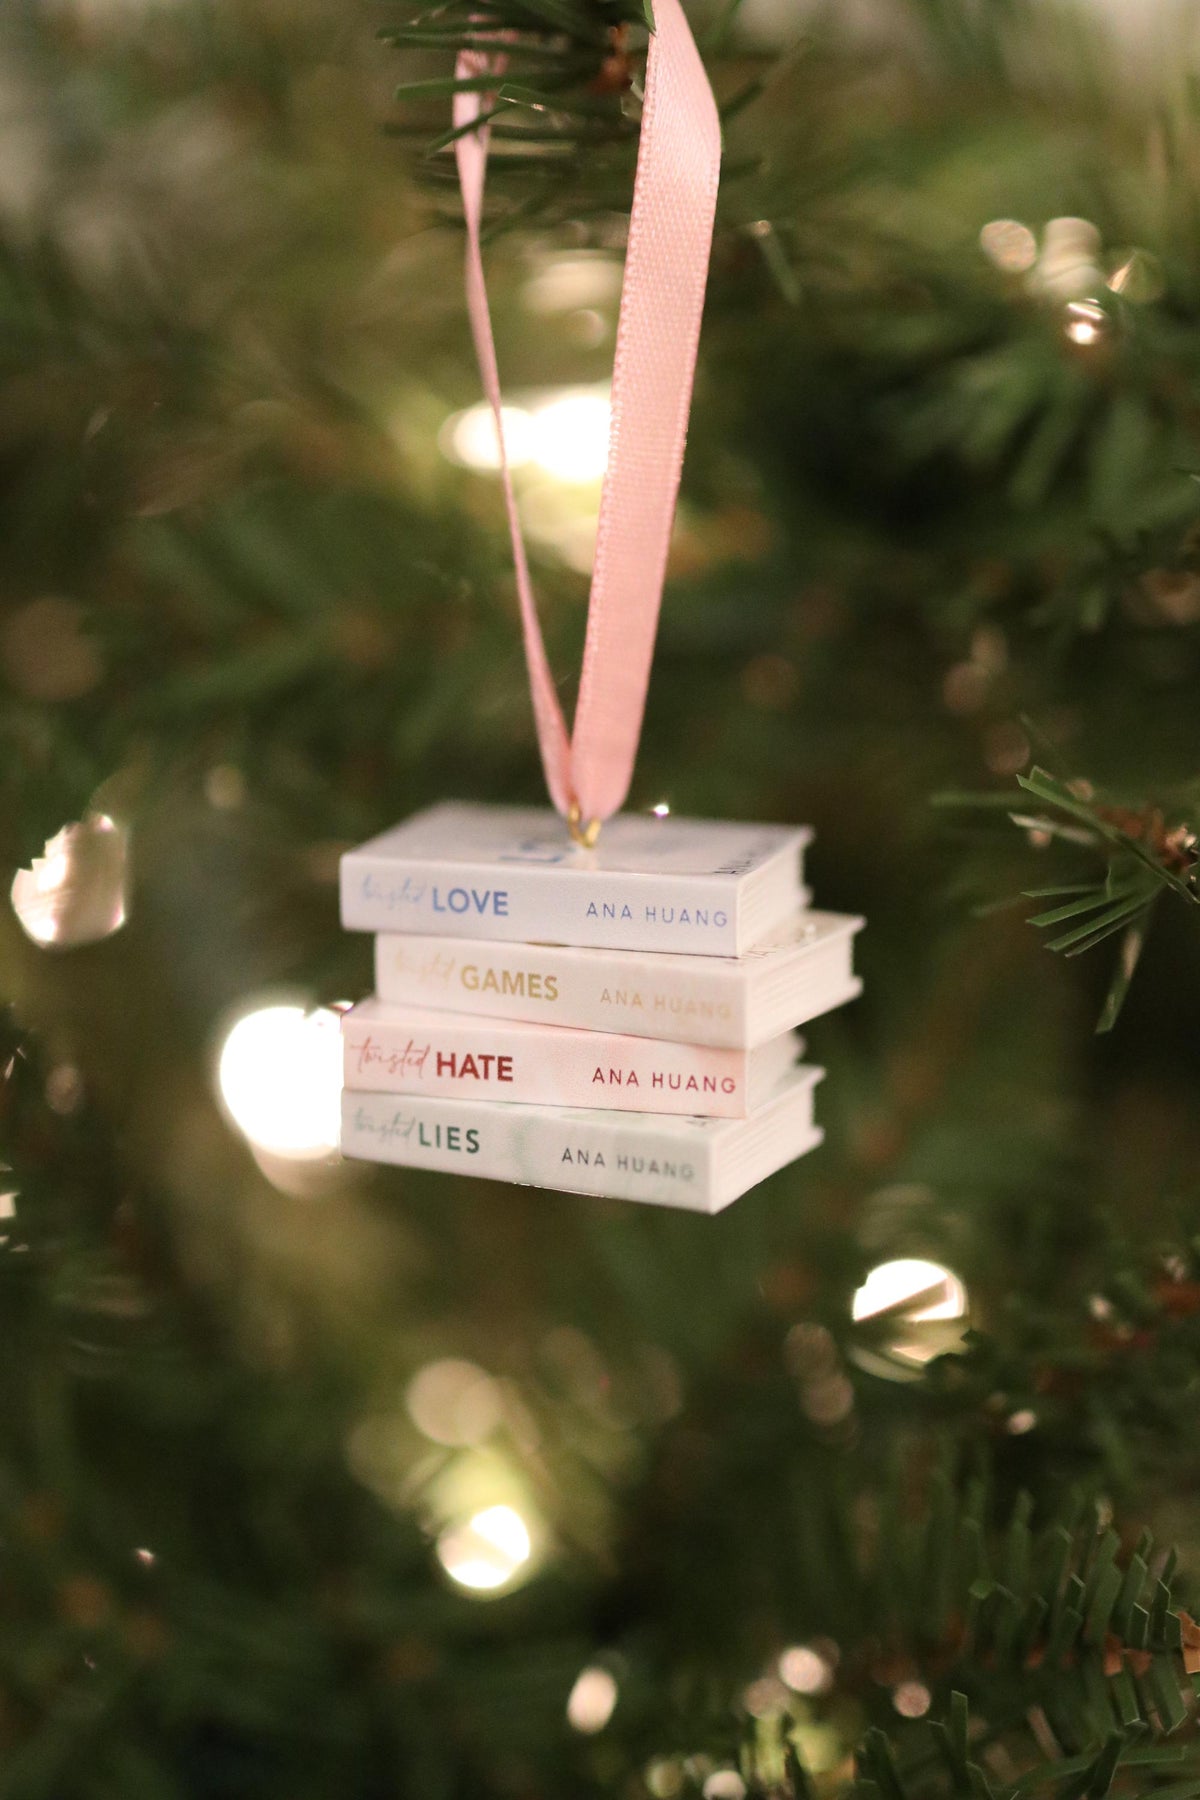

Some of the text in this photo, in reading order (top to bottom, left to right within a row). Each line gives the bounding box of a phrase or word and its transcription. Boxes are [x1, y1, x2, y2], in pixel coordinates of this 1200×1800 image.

[432, 888, 509, 916] LOVE
[586, 902, 728, 928] ANA HUANG
[461, 964, 559, 1002] GAMES
[600, 988, 733, 1020] ANA HUANG
[351, 1036, 514, 1082] twisted HATE
[592, 1067, 736, 1095] ANA HUANG
[418, 1121, 481, 1154] LIES
[562, 1147, 695, 1181] ANA HUANG
